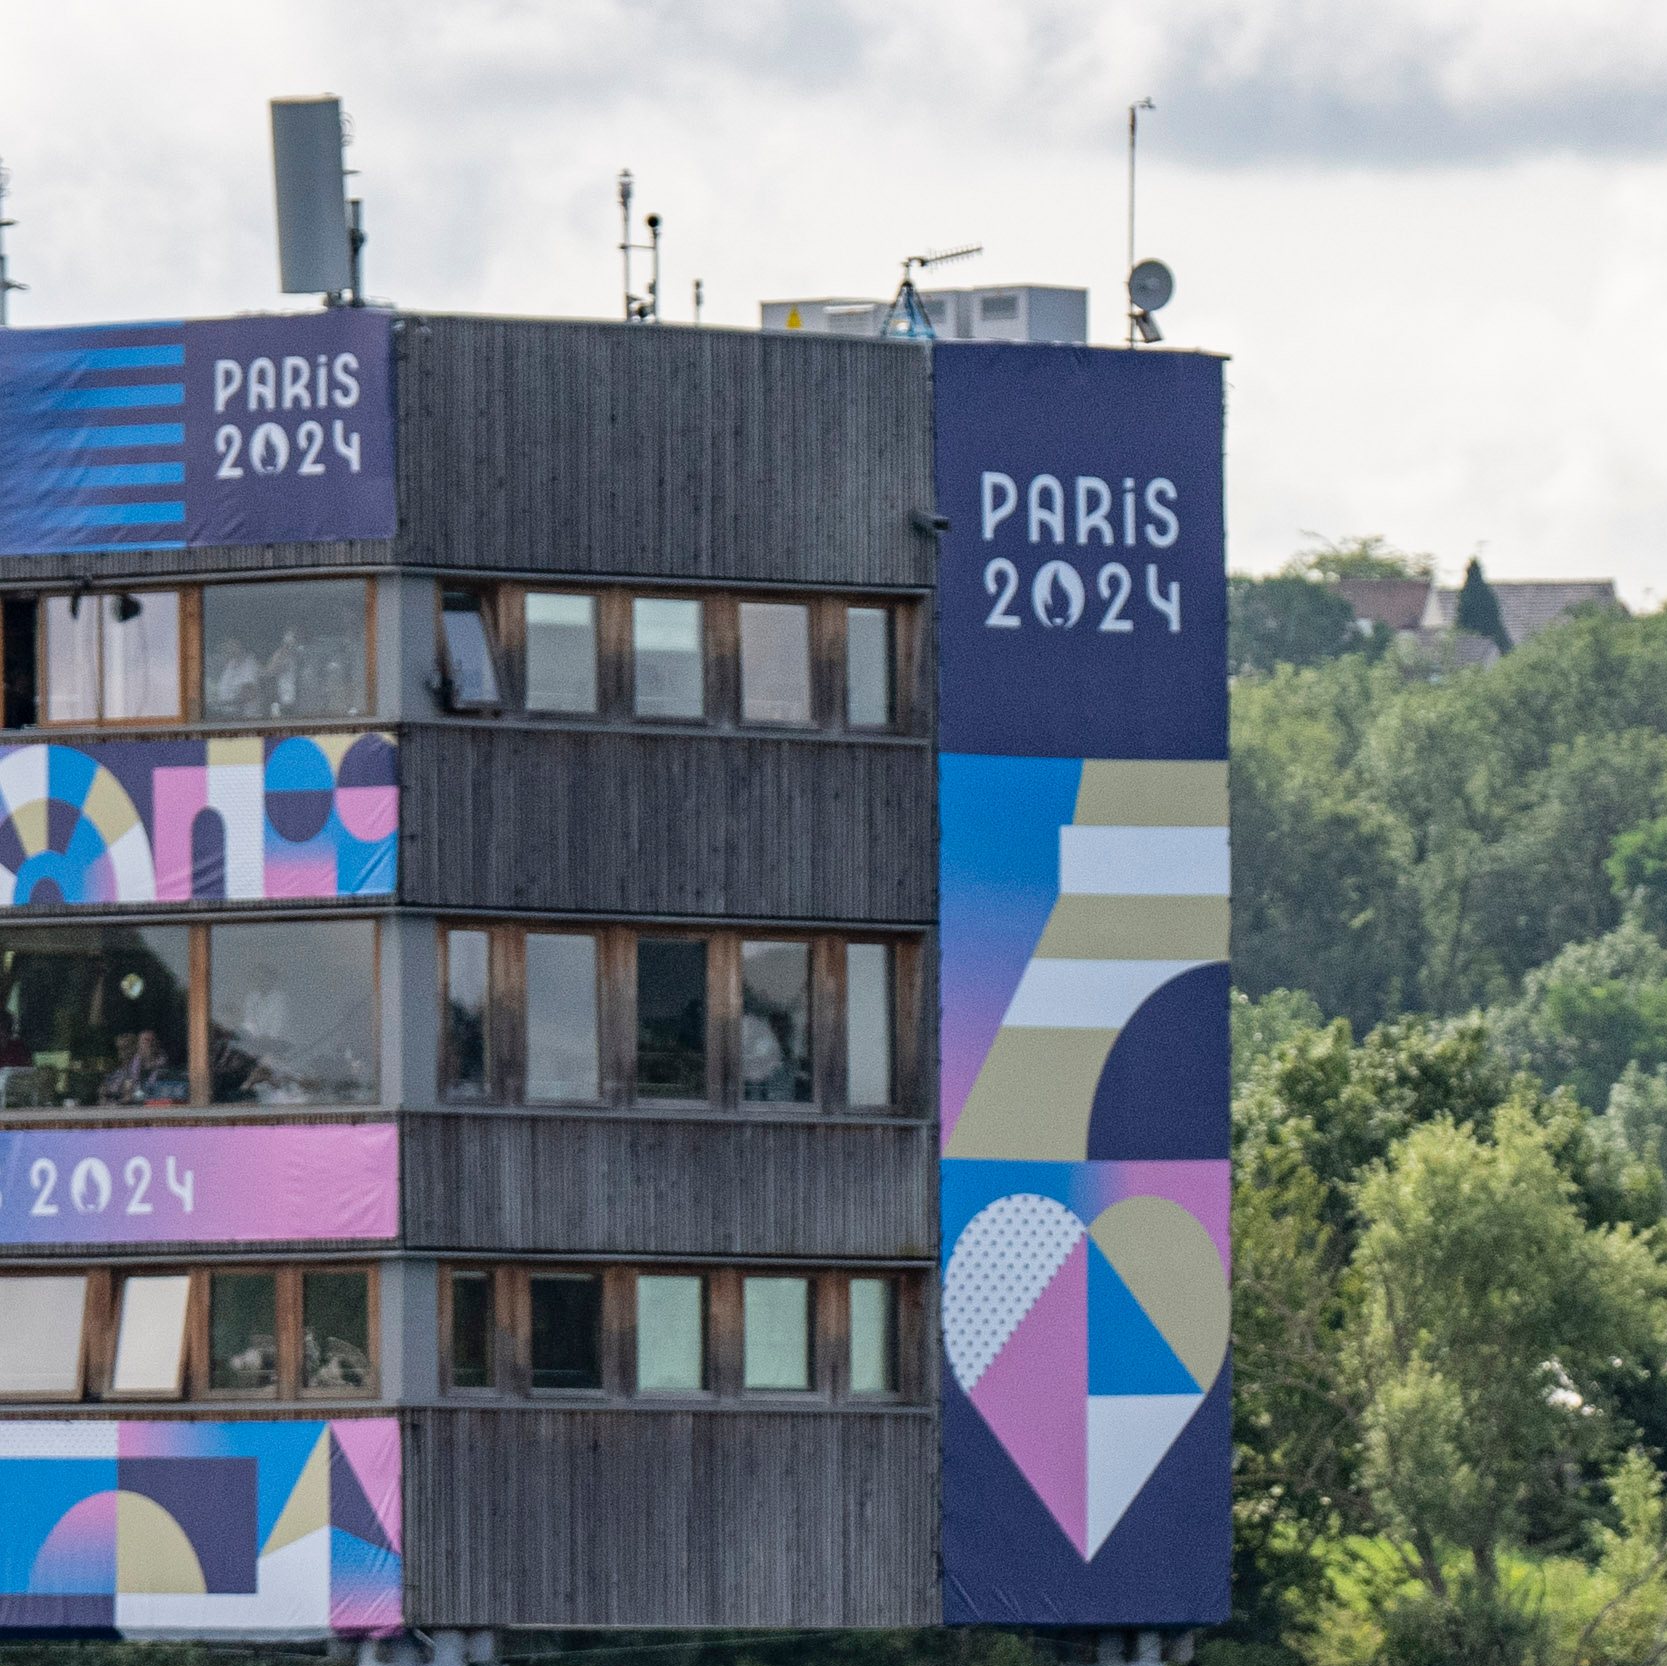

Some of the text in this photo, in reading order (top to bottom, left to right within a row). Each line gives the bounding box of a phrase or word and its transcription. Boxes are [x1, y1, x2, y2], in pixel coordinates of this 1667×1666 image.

[215, 419, 362, 480] 2024
[983, 557, 1182, 633] 2024
[29, 1156, 195, 1217] 2024
